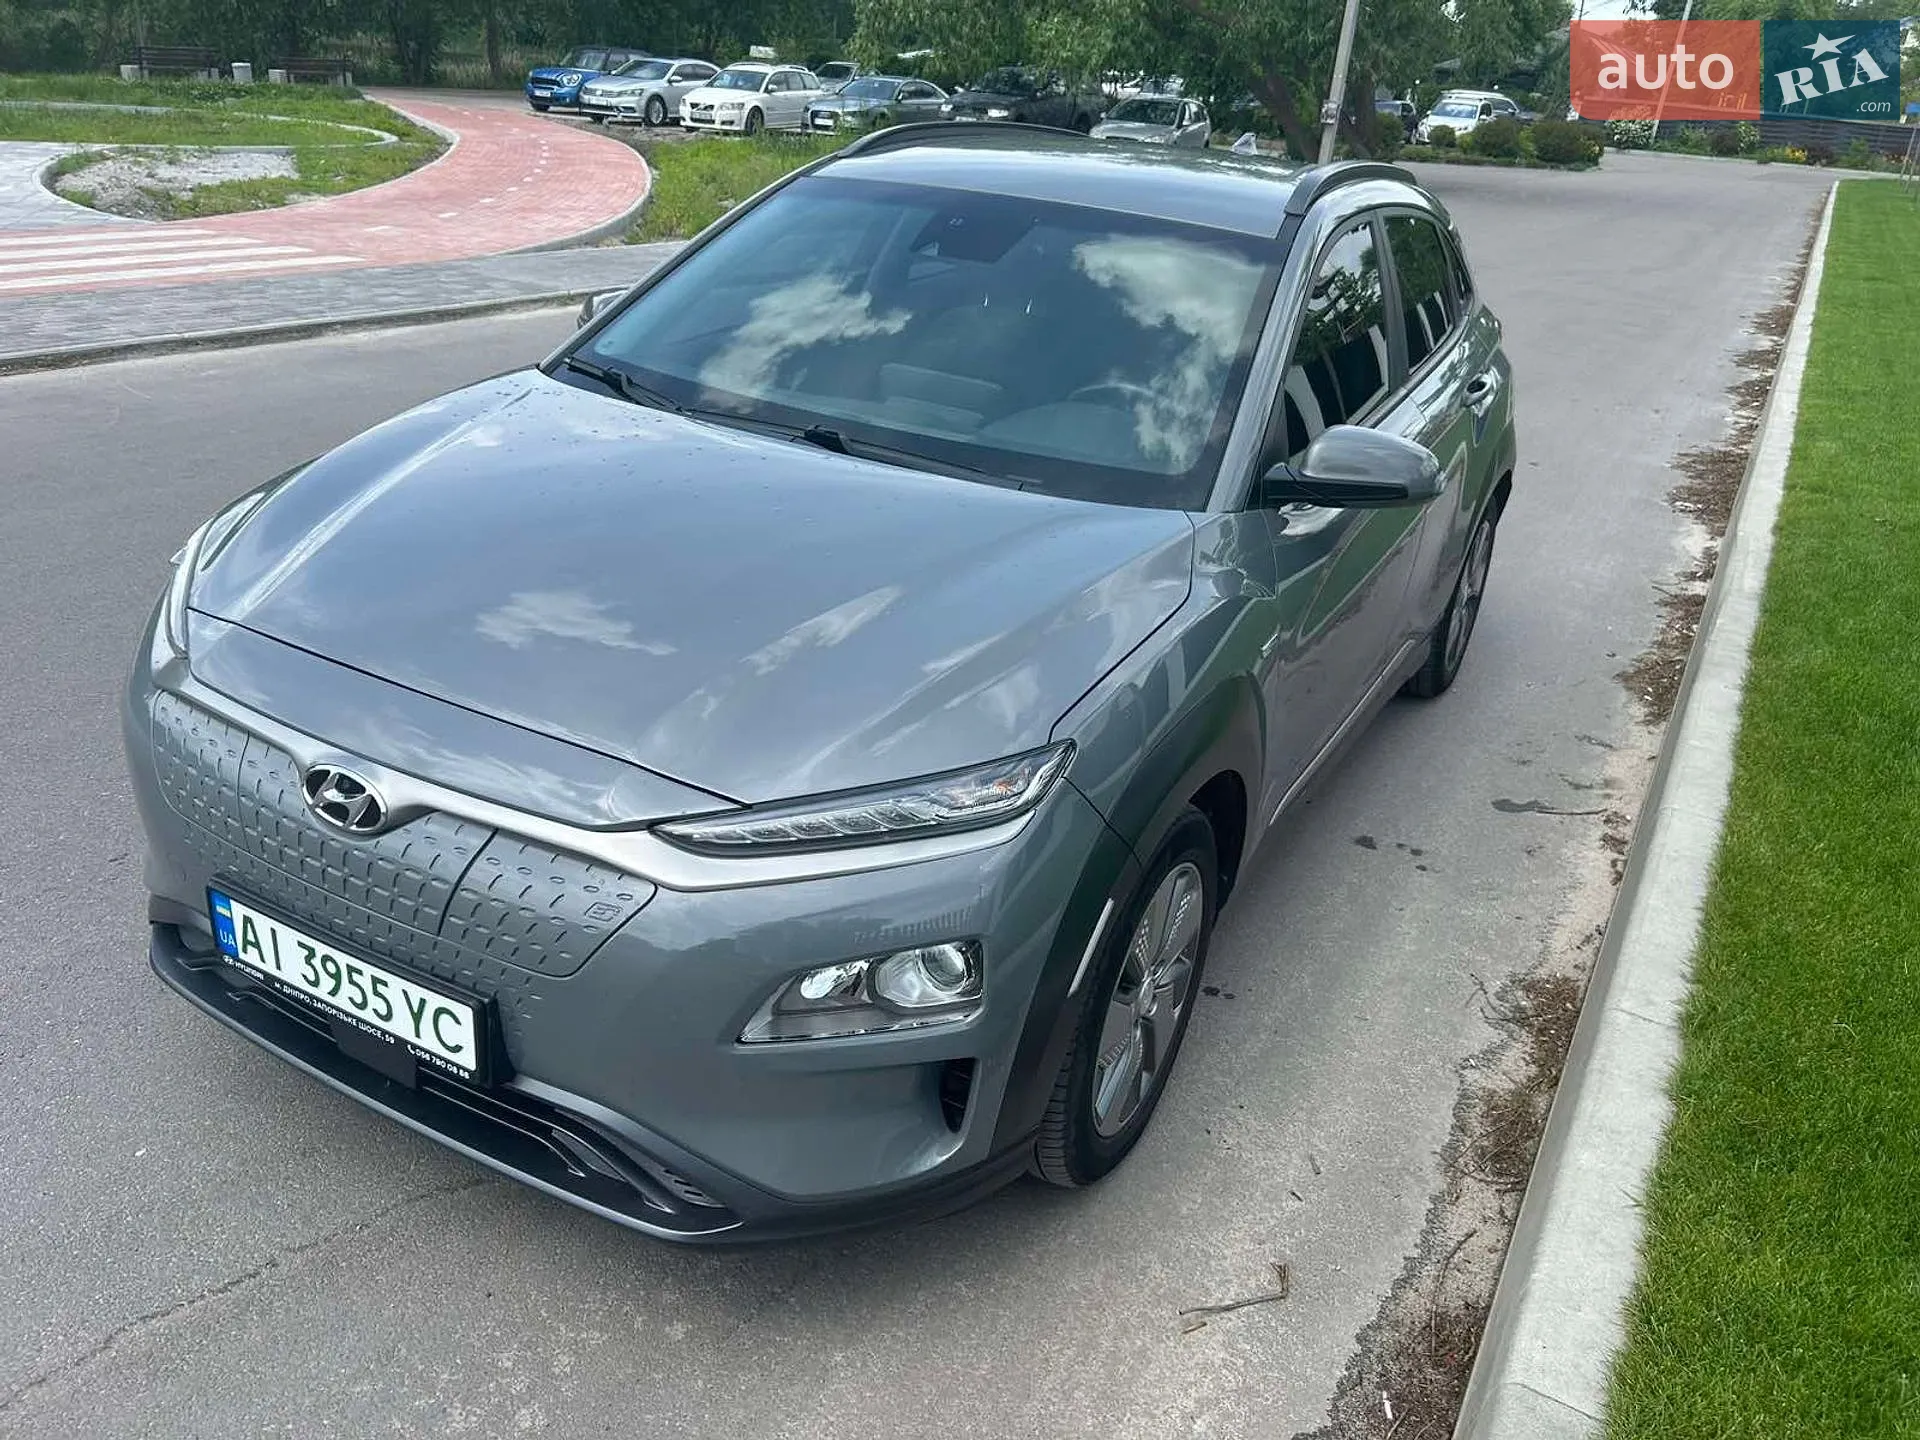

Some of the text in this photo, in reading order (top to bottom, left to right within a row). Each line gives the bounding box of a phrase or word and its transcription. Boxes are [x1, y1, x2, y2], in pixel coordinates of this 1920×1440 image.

[219, 928, 236, 948] UA
[242, 914, 464, 1054] AI 3955 YC
